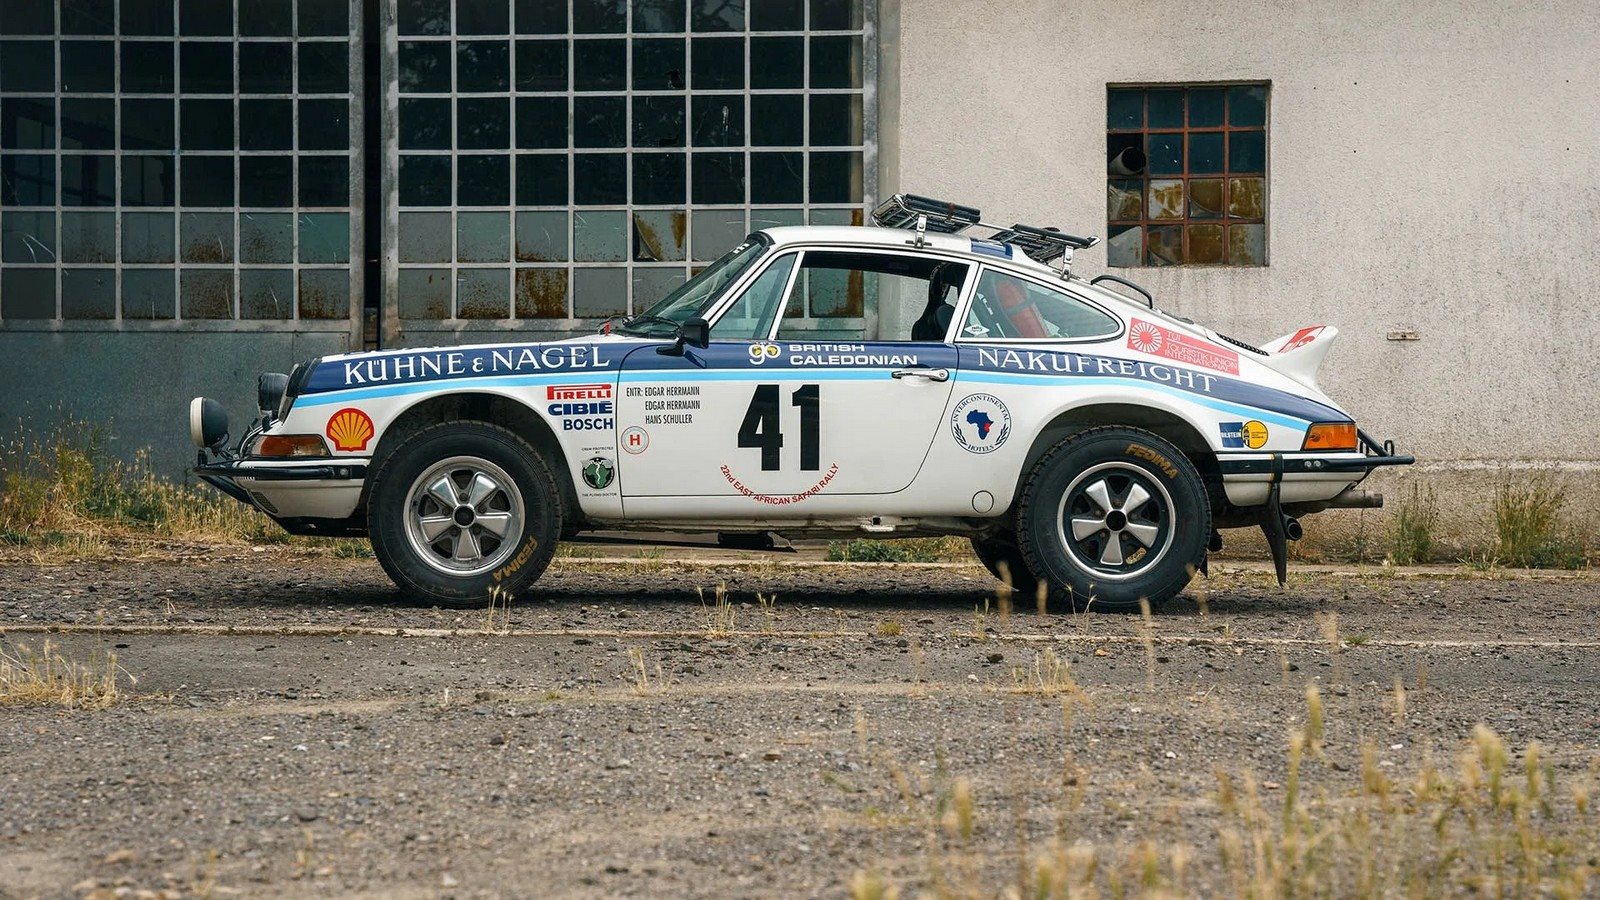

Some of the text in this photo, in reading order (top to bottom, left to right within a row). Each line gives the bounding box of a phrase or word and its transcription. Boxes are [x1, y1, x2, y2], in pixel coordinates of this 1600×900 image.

[1166, 331, 1181, 341] TUI
[789, 344, 865, 352] BRITISH
[1166, 342, 1238, 369] TOURISTIK UNION
[344, 353, 466, 385] KÜHNE
[491, 346, 610, 372] NAGEL
[790, 355, 918, 366] CALEDONIAN
[1164, 350, 1228, 371] INTERNATIONAL
[978, 347, 1218, 393] NAKUFREIGHT
[547, 384, 612, 400] PIRELLI
[626, 386, 700, 397] ENTR: EDGAR HERRMANN
[645, 400, 701, 410] EDGAR HERRMANN
[953, 395, 1009, 422] INTERCONTINENTAL
[563, 418, 614, 430] BOSCH
[645, 414, 693, 424] HANS SCHULLER
[737, 384, 820, 471] 41
[629, 434, 641, 446] H
[967, 444, 994, 452] HOTELS
[1125, 443, 1178, 479] FEDIMA
[720, 463, 839, 505] 22nd EAST AFRICAN SAFARI RALLY
[492, 535, 538, 582] FEDIMA
